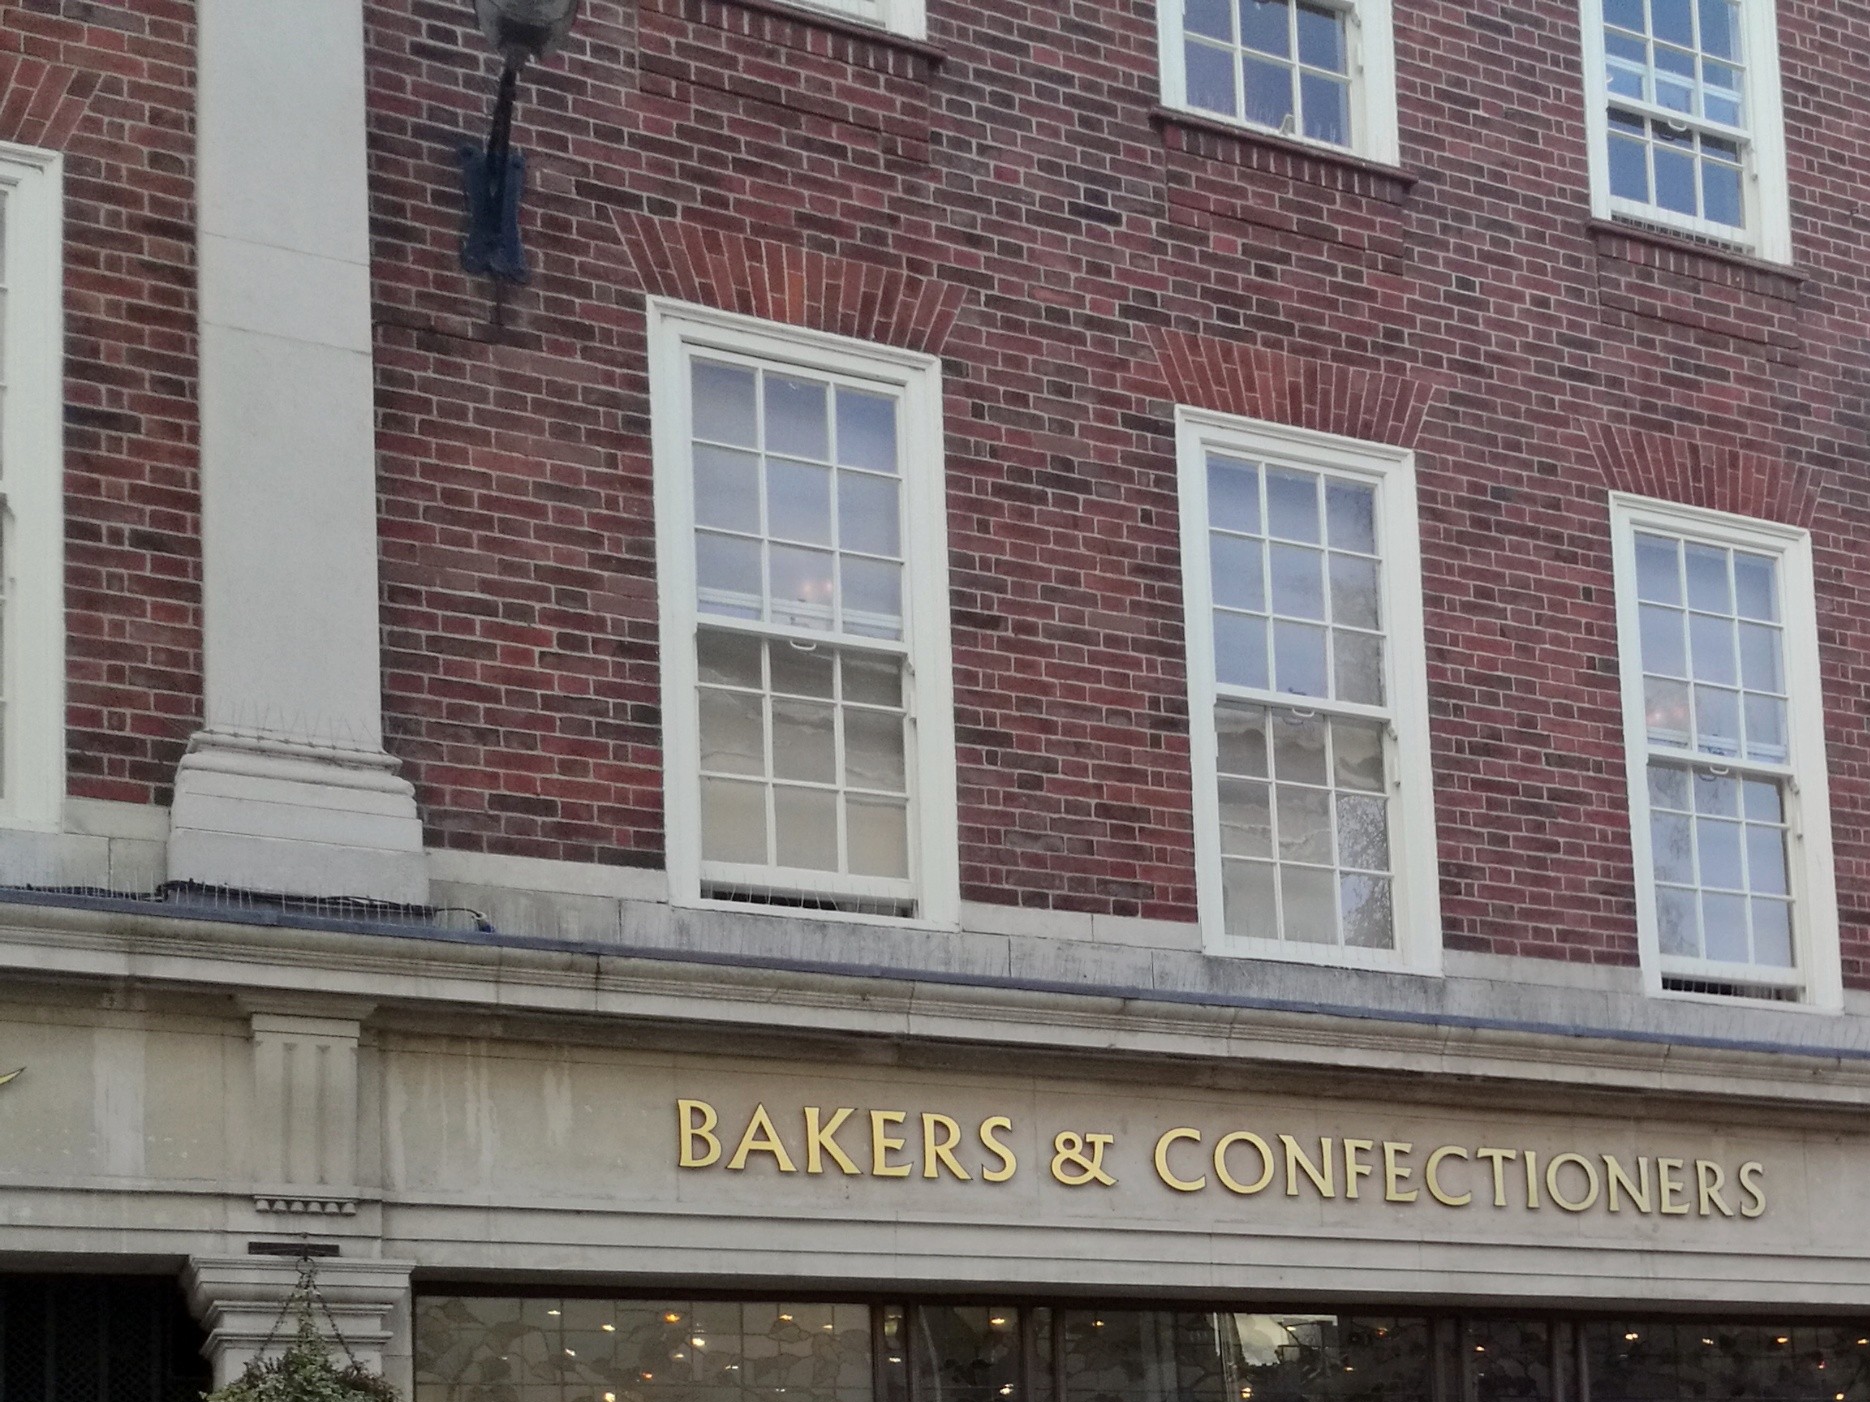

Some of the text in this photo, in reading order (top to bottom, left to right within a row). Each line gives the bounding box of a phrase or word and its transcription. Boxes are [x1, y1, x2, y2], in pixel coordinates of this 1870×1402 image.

[676, 1098, 1767, 1219] BAKERS & CONFECTIONERS
